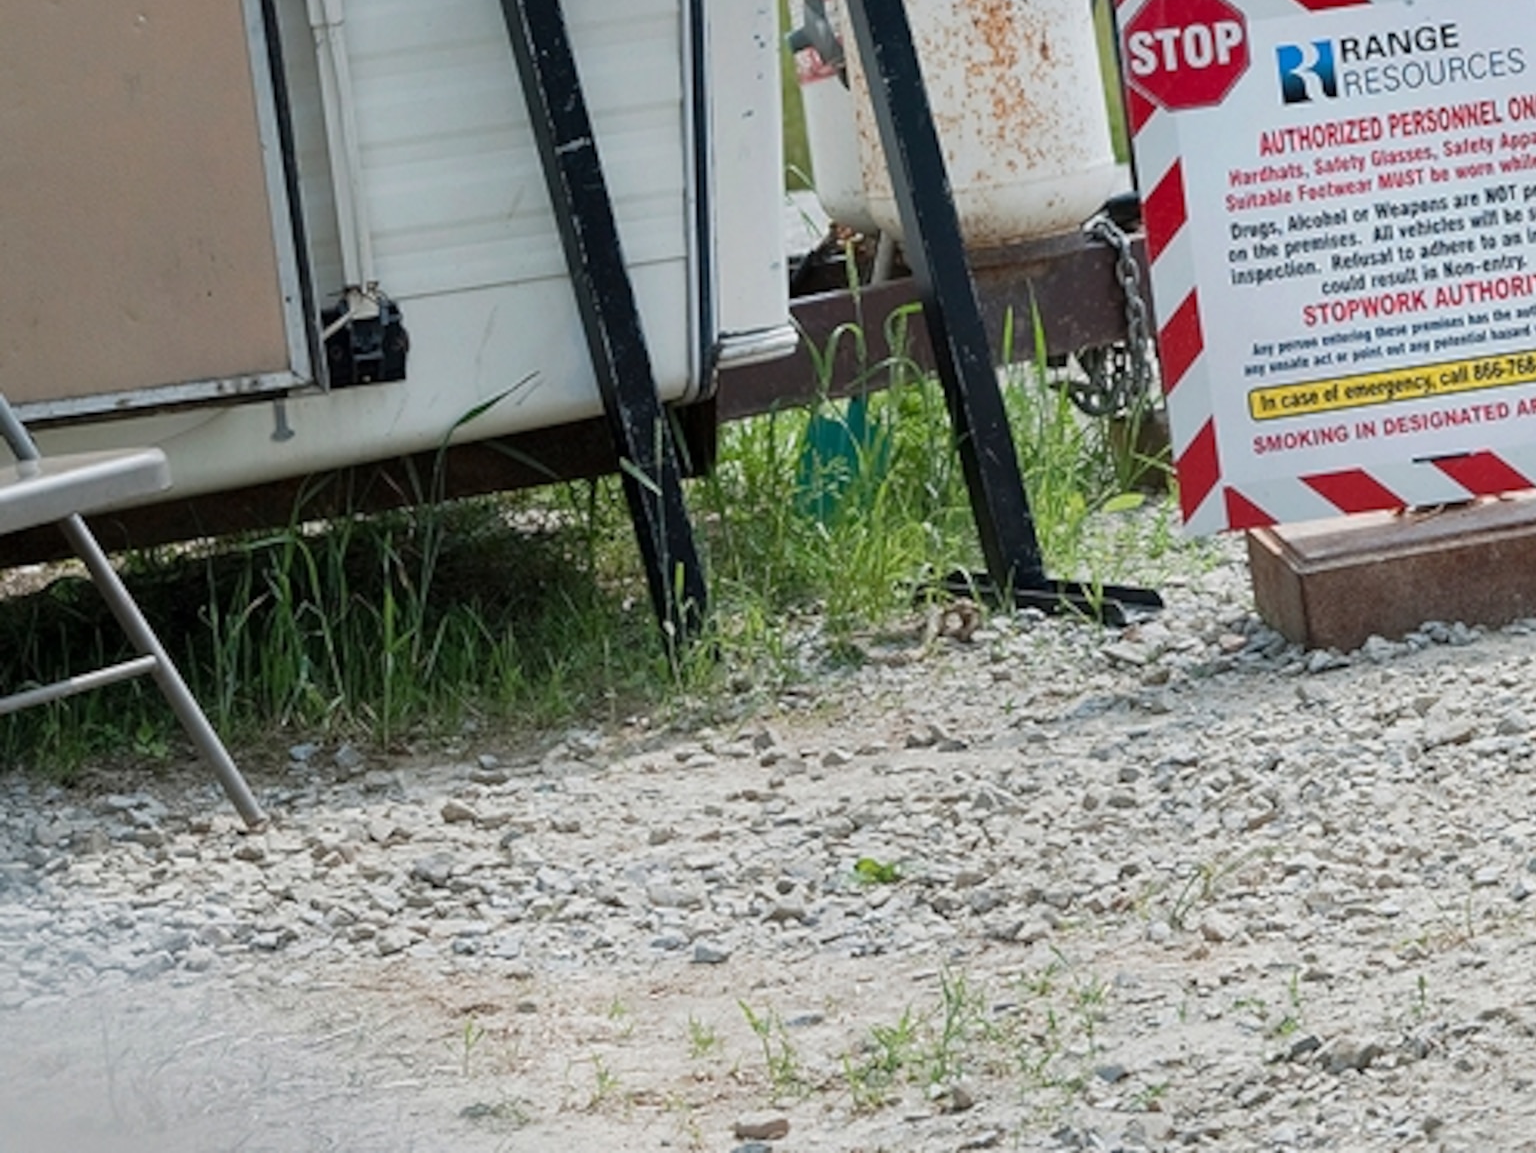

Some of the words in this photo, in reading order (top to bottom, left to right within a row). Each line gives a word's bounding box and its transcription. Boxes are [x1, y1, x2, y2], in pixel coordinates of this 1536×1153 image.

[1128, 20, 1243, 75] STOP
[1340, 23, 1460, 62] RANGE
[1343, 48, 1526, 98] RESOURCES
[1259, 117, 1382, 156] AUTHORIZED
[1388, 100, 1503, 137] PERSONNEL
[1225, 188, 1292, 212] Suitable
[1298, 179, 1371, 201] Footwear
[1378, 169, 1424, 189] MUST
[1431, 166, 1449, 183] be
[1455, 162, 1494, 178] worn
[1229, 163, 1309, 187] Hardhats,
[1314, 154, 1366, 176] Safety
[1371, 145, 1438, 167] Glasses,
[1443, 136, 1494, 158] Safety
[1229, 248, 1247, 263] on
[1254, 241, 1279, 259] the
[1285, 232, 1362, 258] premises.
[1374, 225, 1393, 242] All
[1399, 215, 1464, 238] vehicles
[1471, 210, 1498, 228] will
[1503, 207, 1523, 224] be
[1230, 221, 1283, 241] Drugs,
[1288, 209, 1347, 231] Alcohol
[1353, 208, 1368, 222] or
[1374, 196, 1448, 219] Weapons
[1454, 194, 1480, 208] are
[1485, 184, 1517, 203] NOT
[1231, 260, 1322, 286] inspection.
[1331, 247, 1393, 270] Refusal
[1399, 246, 1414, 262] to
[1420, 238, 1474, 255] adhere
[1480, 233, 1496, 249] to
[1503, 232, 1523, 247] an
[1322, 272, 1365, 295] could
[1371, 268, 1418, 288] result
[1423, 264, 1439, 280] in
[1443, 254, 1527, 278] Non-entry.
[1303, 290, 1427, 327] STOPWORK
[1261, 395, 1276, 411] In
[1281, 392, 1319, 409] case
[1324, 384, 1340, 402] of
[1440, 366, 1469, 386] call
[1253, 425, 1349, 455] SMOKING
[1355, 422, 1377, 439] IN
[1383, 402, 1509, 435] DESIGNATED
